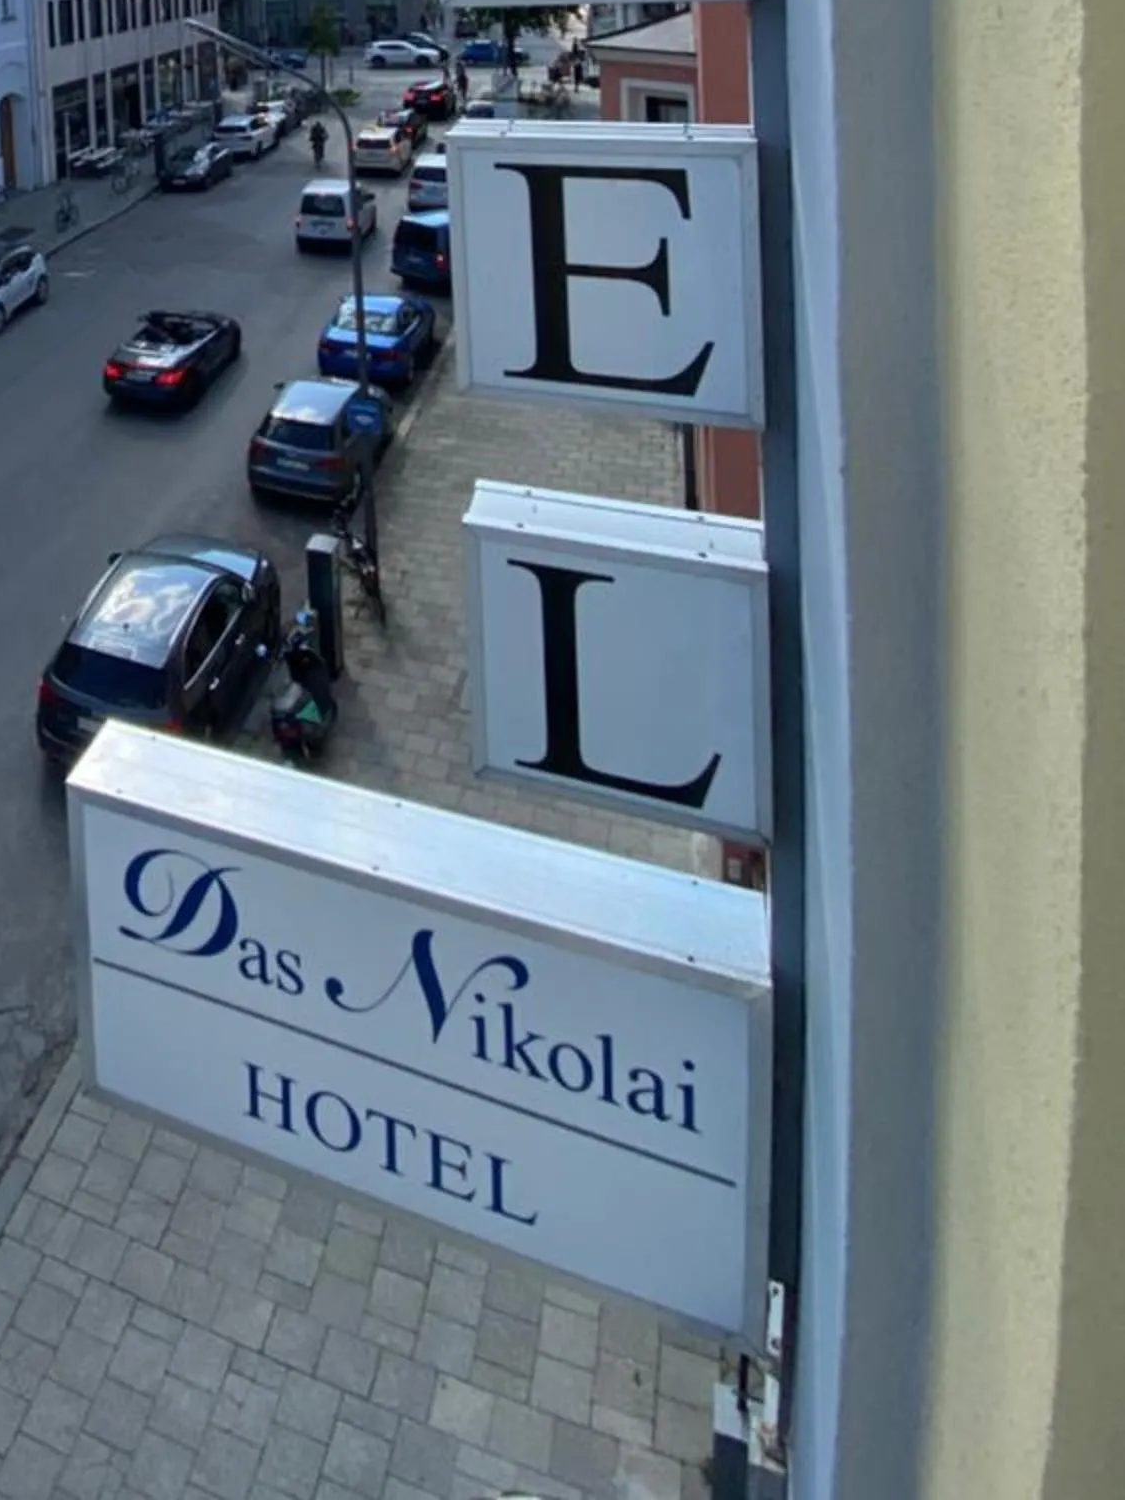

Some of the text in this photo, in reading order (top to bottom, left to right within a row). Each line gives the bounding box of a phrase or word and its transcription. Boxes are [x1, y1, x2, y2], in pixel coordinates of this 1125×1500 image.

[119, 847, 703, 1134] Das Nikolai
[242, 1061, 539, 1226] HOTEL
